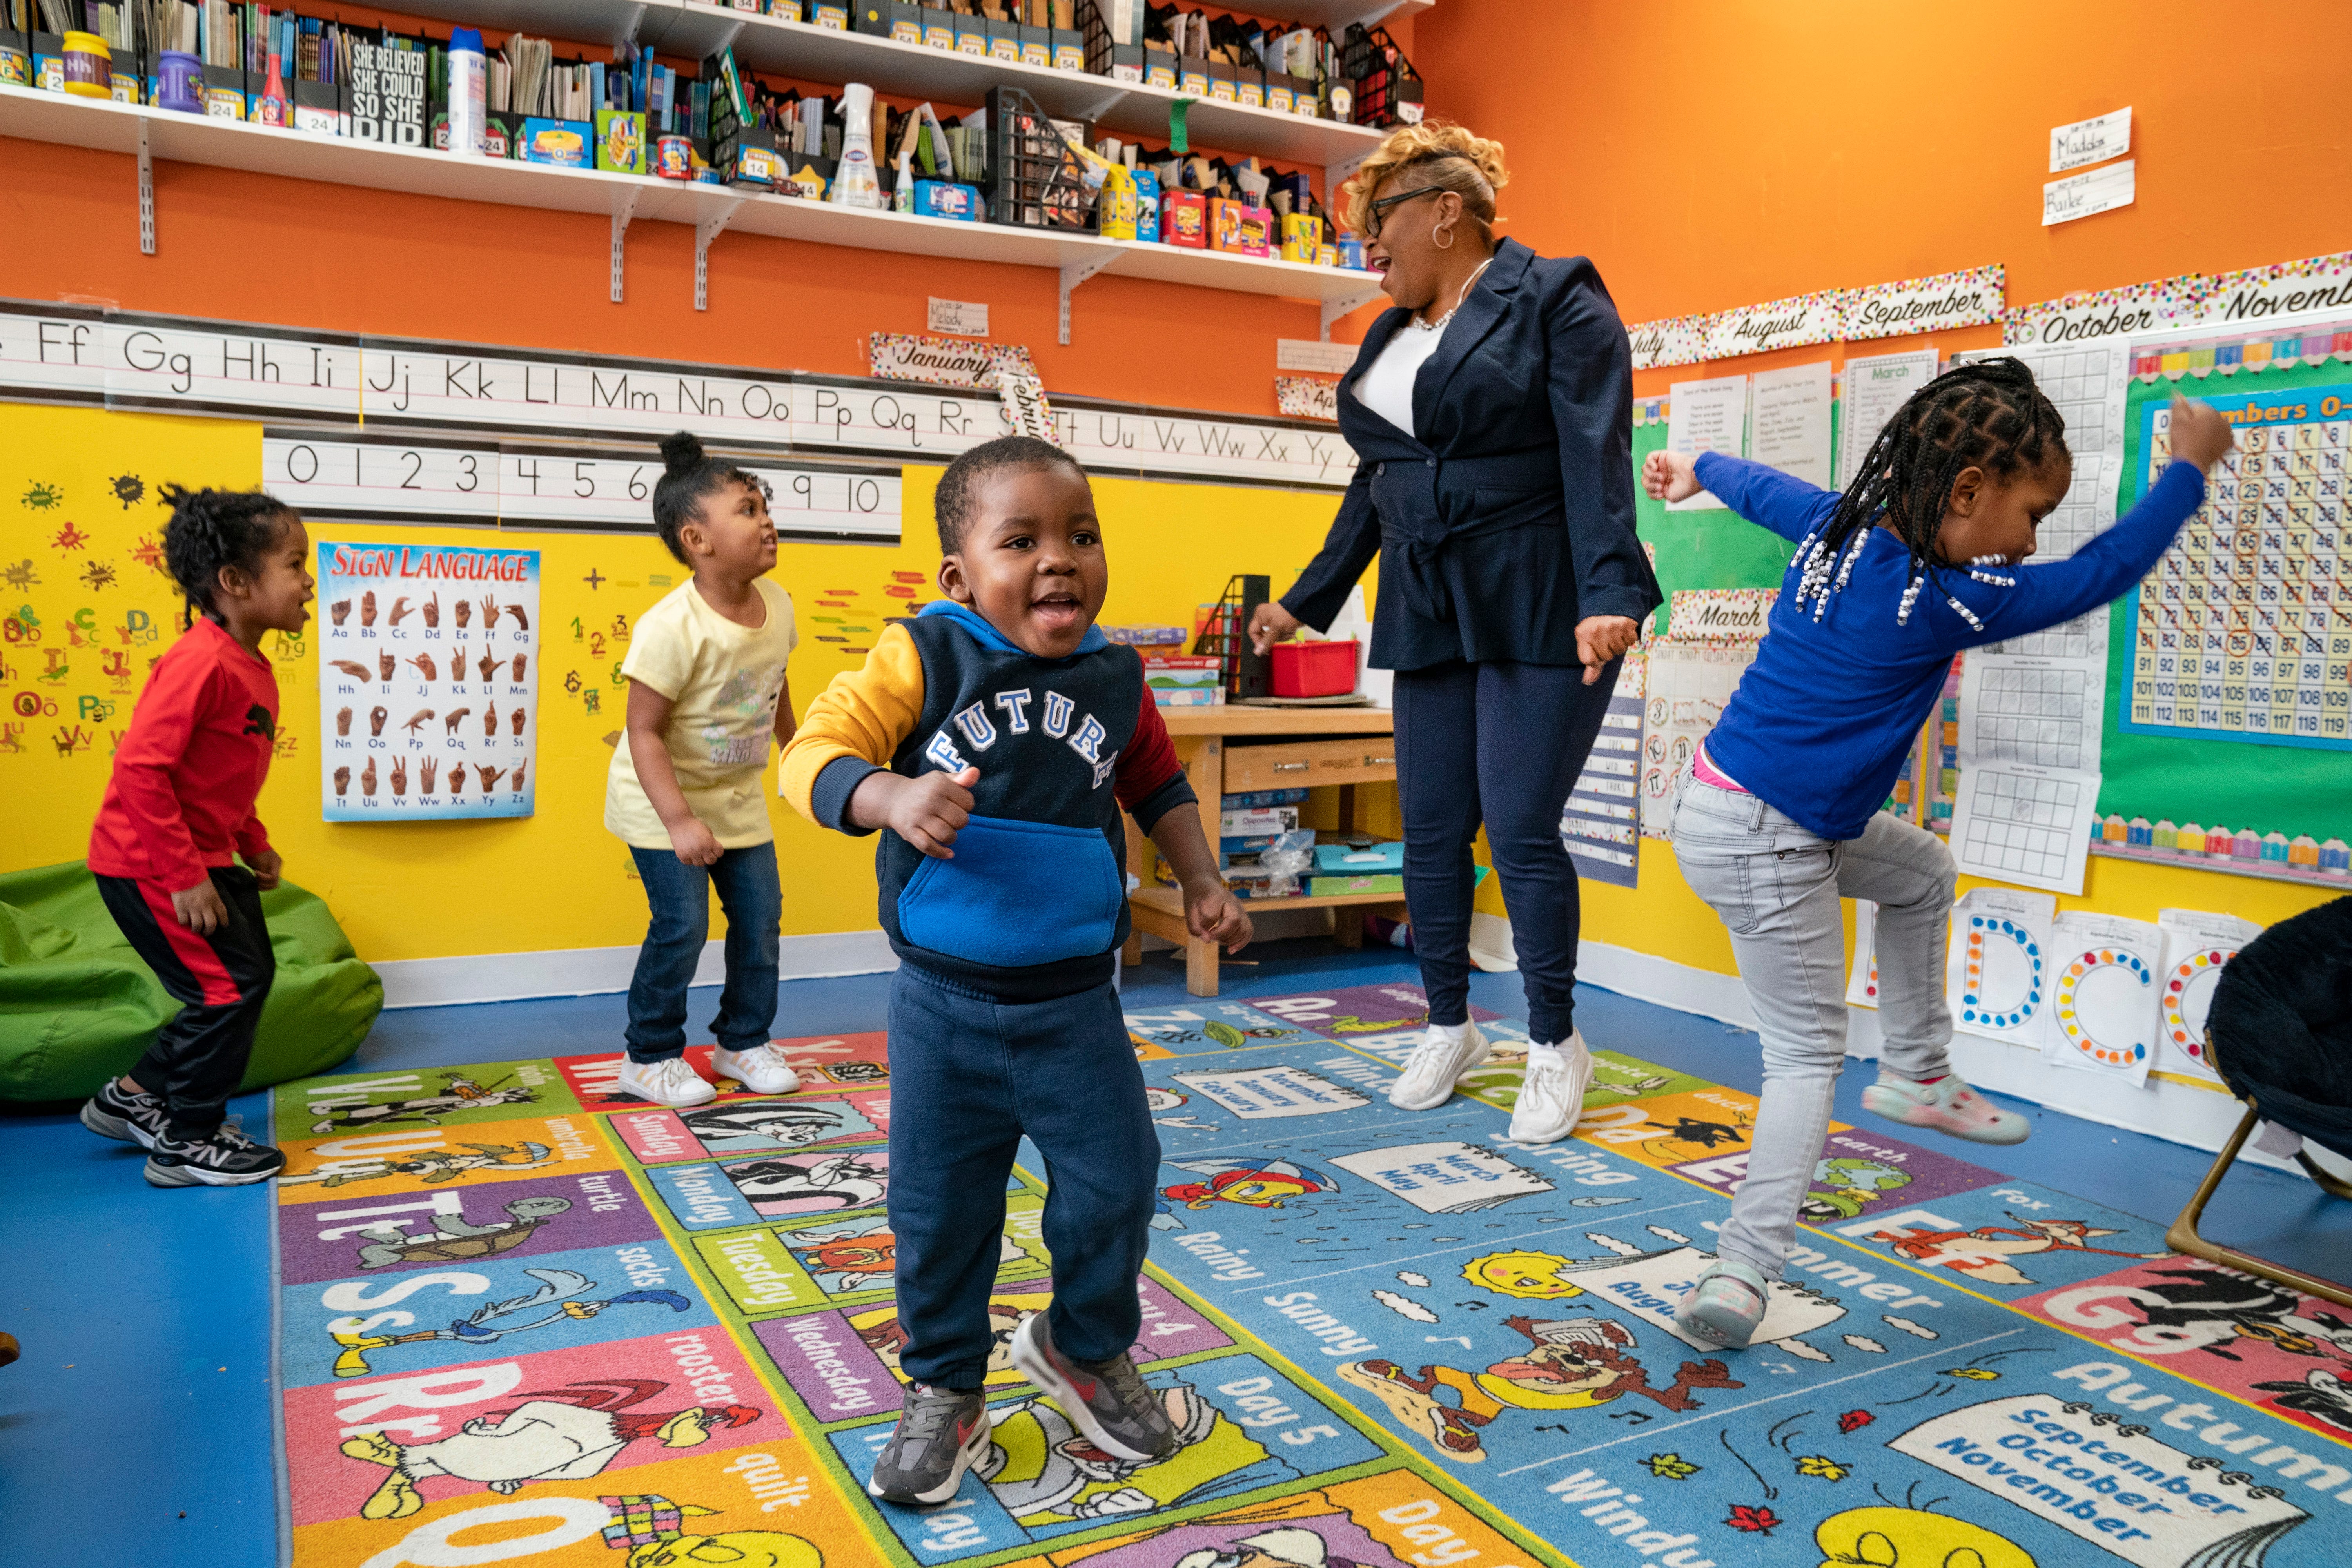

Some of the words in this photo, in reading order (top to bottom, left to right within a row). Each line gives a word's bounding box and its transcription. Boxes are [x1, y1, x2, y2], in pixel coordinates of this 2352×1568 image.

[67, 60, 92, 73] Hh
[354, 44, 374, 69] SHE
[376, 47, 425, 76] BELIEVED
[353, 68, 378, 94] SHE
[381, 72, 424, 100] COULD
[213, 104, 232, 117] 24
[311, 118, 329, 131] 24
[353, 93, 379, 118] SO
[385, 97, 423, 124] SHE
[353, 116, 422, 147] DID
[750, 163, 764, 174] 14
[1859, 289, 1983, 328] September
[2043, 305, 2154, 343] October
[1733, 310, 1808, 347] August
[900, 346, 992, 383] January
[1872, 366, 1909, 380] March
[39, 322, 90, 365] Ff
[124, 332, 192, 393] Gg
[223, 340, 279, 383] Hh
[310, 348, 332, 388] Ii
[368, 356, 409, 411] Jj
[446, 360, 493, 400] Kk
[526, 366, 558, 404] Ll
[592, 372, 658, 411] Mm
[679, 380, 724, 416] Nn
[742, 385, 789, 421] Oo
[816, 390, 852, 441] Pp
[871, 396, 921, 447] Qq
[940, 401, 972, 434] Rr
[1100, 418, 1134, 449] Uu
[1155, 423, 1184, 453] Vv
[1200, 428, 1244, 457] Ww
[1256, 430, 1287, 461] Xx
[1305, 434, 1333, 479] Yy
[2221, 403, 2307, 423] mbers
[287, 445, 318, 484] 0
[400, 452, 422, 490] 2
[456, 455, 478, 492] 3
[518, 459, 541, 496] 4
[574, 463, 595, 499] 5
[628, 466, 648, 501] 6
[793, 475, 811, 510] 9
[848, 479, 879, 513] 10
[331, 546, 395, 577] SIGN
[400, 548, 531, 582] LANGUAGE
[1698, 603, 1762, 627] March
[332, 630, 348, 638] Aa
[361, 630, 377, 638] Bb
[392, 630, 407, 639] Cc
[425, 630, 441, 639] Dd
[457, 630, 469, 640] Ee
[485, 630, 495, 640] Ff
[514, 632, 529, 644] Gg
[591, 632, 606, 655] 2
[2139, 657, 2151, 670] 91
[2160, 658, 2174, 671] 92
[2182, 659, 2196, 673] 93
[2205, 660, 2220, 673] 94
[2229, 661, 2243, 675] 95
[2253, 662, 2269, 676] 96
[2279, 663, 2294, 677] 97
[2303, 664, 2320, 678] 98
[2330, 665, 2347, 679] 99
[338, 684, 355, 694] Hh
[382, 684, 390, 695] Ii
[417, 685, 428, 697] Jj
[452, 685, 466, 695] Kk
[483, 685, 493, 695] Ll
[509, 686, 528, 695] Mm
[2136, 682, 2152, 695] 101
[2157, 683, 2174, 696] 102
[2179, 684, 2196, 697] 103
[2201, 685, 2220, 699] 104
[2225, 686, 2244, 700] 105
[2249, 688, 2269, 701] 106
[2275, 689, 2294, 703] 107
[2299, 690, 2320, 704] 108
[2325, 692, 2347, 706] 109
[335, 739, 352, 748] Nn
[368, 739, 386, 748] Oo
[409, 739, 423, 751] Pp
[446, 739, 466, 750] Qq
[484, 739, 497, 747] Rr
[513, 739, 524, 747] Ss
[336, 798, 347, 808] Tt
[363, 798, 379, 808] Uu
[392, 798, 407, 806] Vv
[418, 797, 440, 806] Ww
[451, 796, 466, 806] Xx
[482, 795, 495, 807] Yy
[512, 794, 524, 804] Zz
[1263, 1073, 1339, 1103] December
[1693, 1092, 1755, 1114] duck
[544, 1116, 598, 1161] umbrella
[628, 1114, 684, 1156] Sunday
[1831, 1135, 1909, 1163] earth
[1376, 1169, 1425, 1191] May
[1407, 1162, 1469, 1185] April
[1437, 1153, 1501, 1182] March
[577, 1174, 627, 1213] turtle
[667, 1167, 735, 1223] Monday
[1990, 1187, 2051, 1211] fox
[615, 1246, 667, 1287] socks
[717, 1233, 796, 1305] Tuesday
[1172, 1231, 1265, 1282] Rainy
[1263, 1292, 1378, 1357] Sunny
[666, 1335, 738, 1403] rooster
[783, 1317, 876, 1411] Wednesday
[333, 1361, 523, 1438] Rr
[1217, 1376, 1300, 1428] Day
[1281, 1424, 1340, 1445] 5
[2053, 1361, 2352, 1504] Autum
[1997, 1433, 2176, 1516] October
[2009, 1408, 2248, 1516] September
[723, 1453, 810, 1512] quilt
[1936, 1436, 2153, 1542] November
[1378, 1500, 1479, 1566] Day
